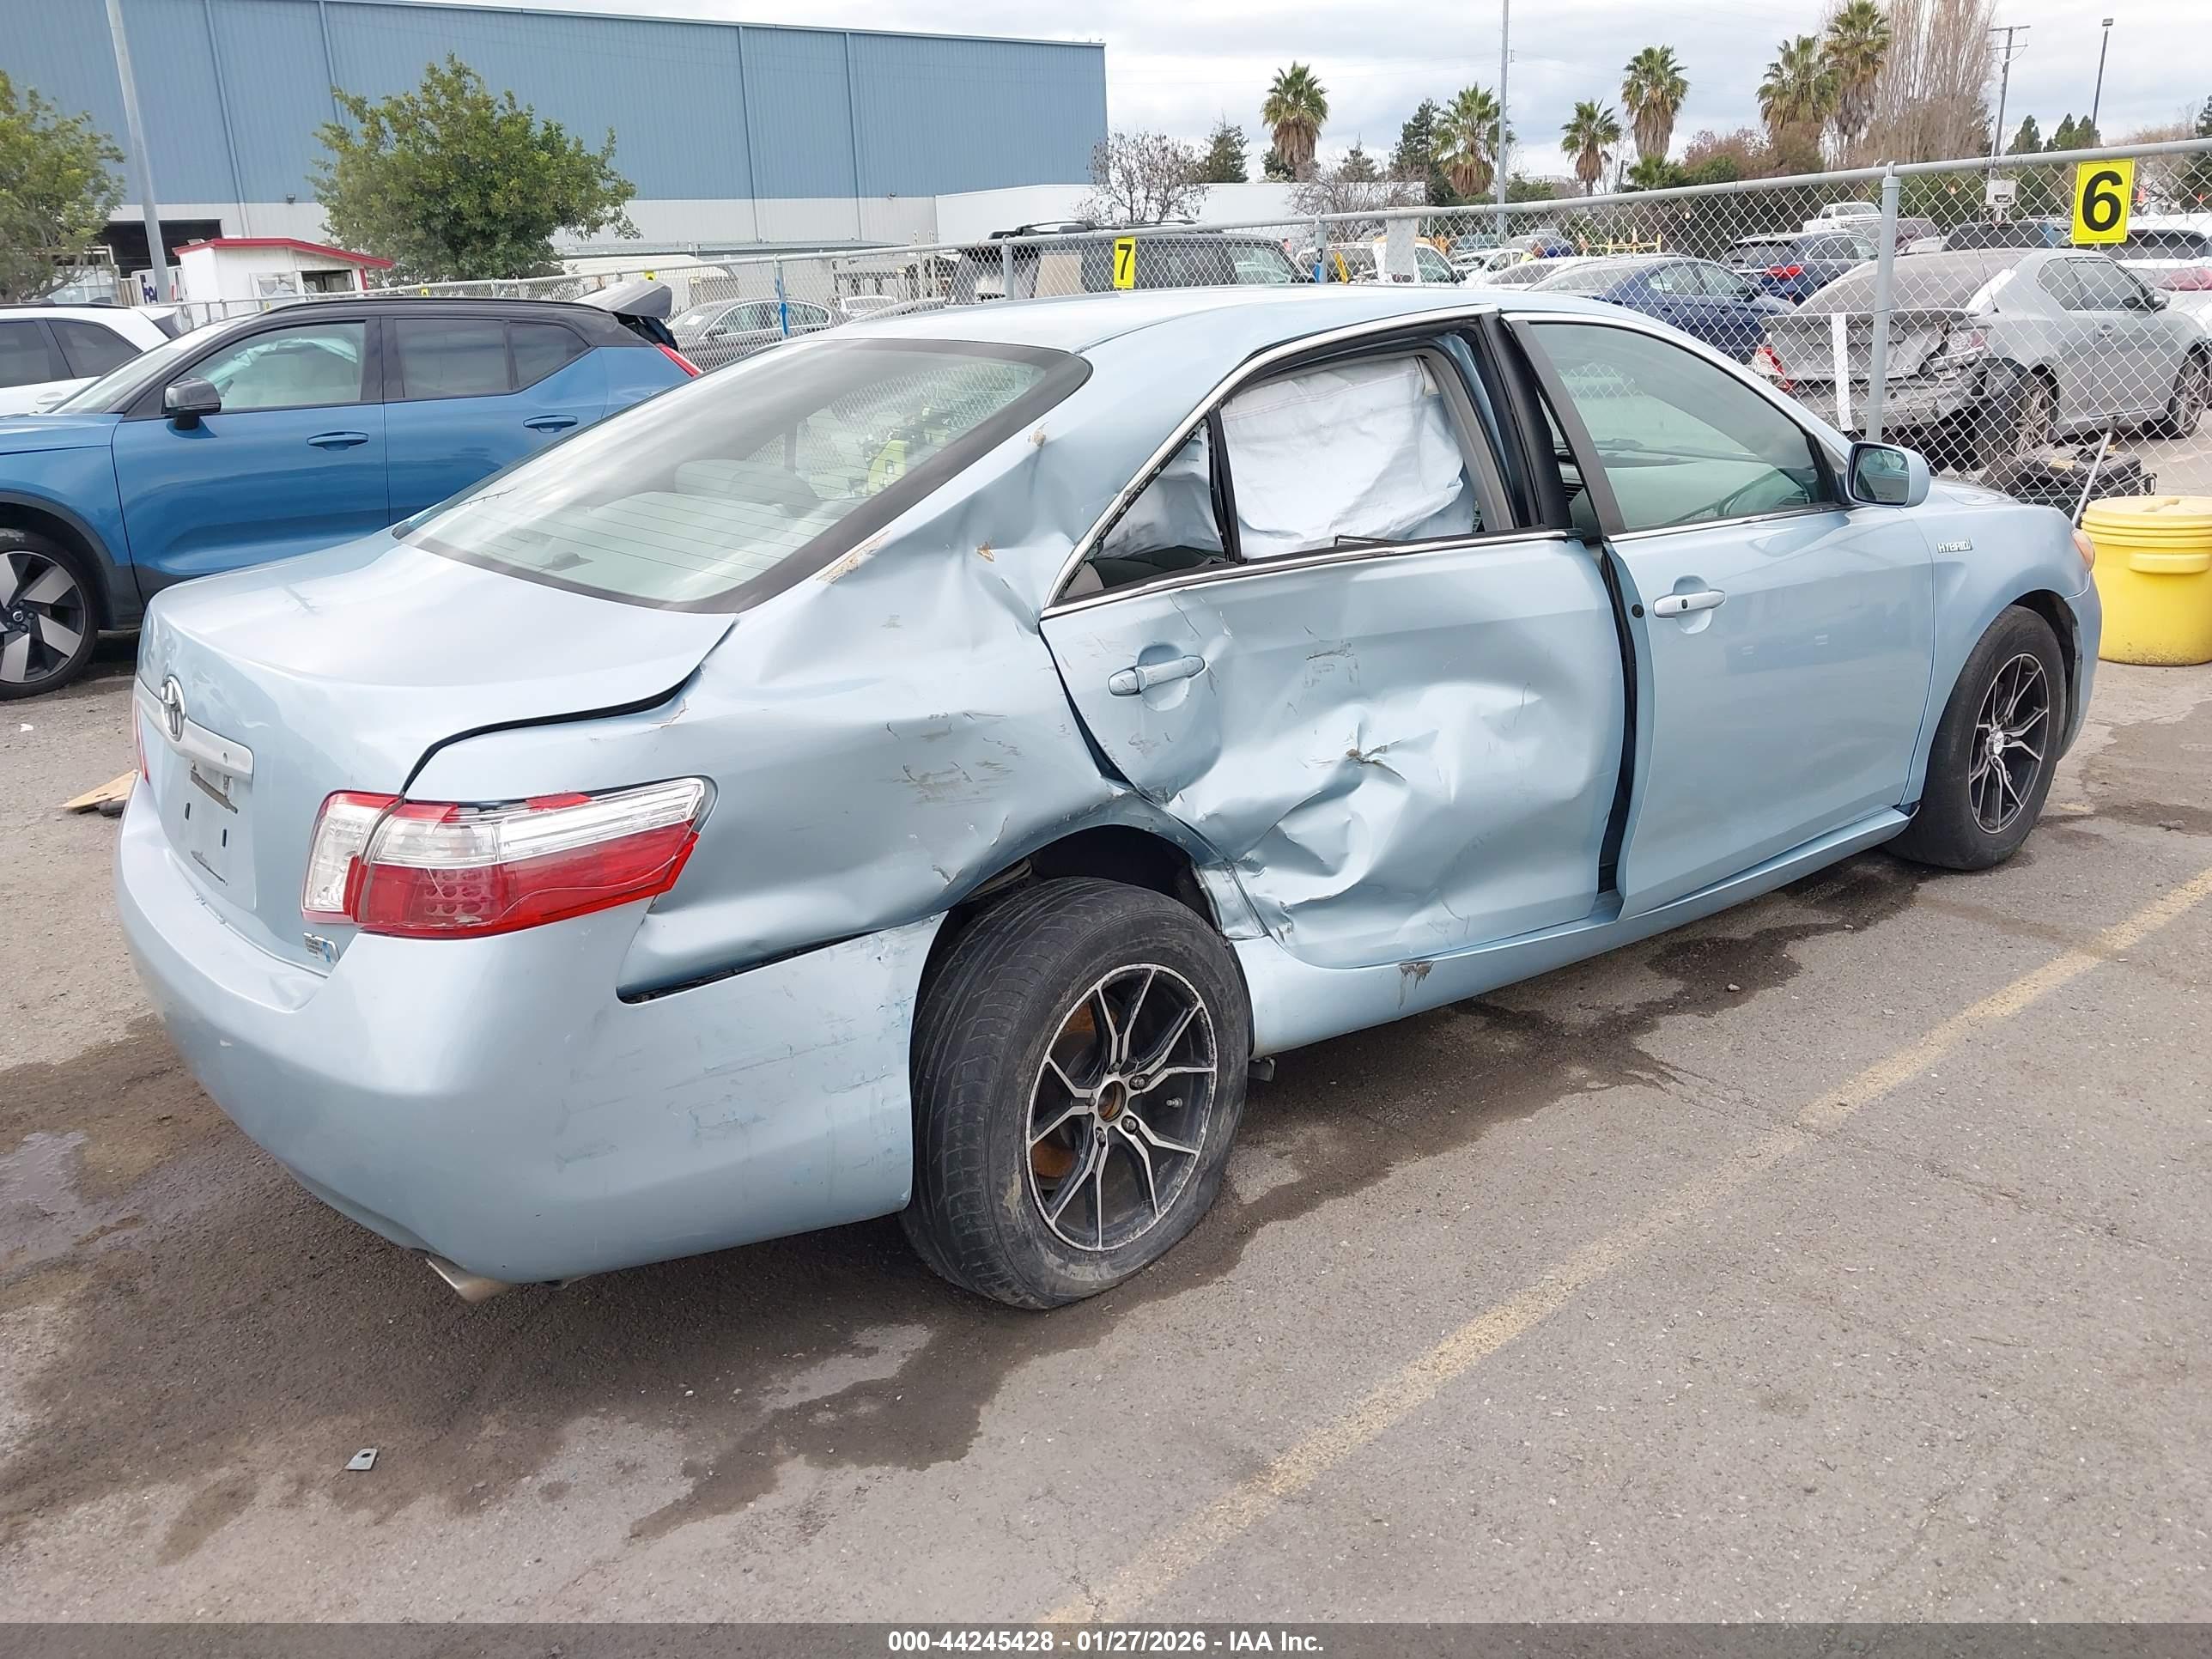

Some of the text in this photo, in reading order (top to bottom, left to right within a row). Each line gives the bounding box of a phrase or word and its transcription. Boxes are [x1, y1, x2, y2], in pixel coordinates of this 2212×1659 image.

[2082, 170, 2124, 232] 6
[1118, 244, 1132, 280] 7
[1316, 247, 1323, 264] 3
[1936, 541, 1972, 554] HYBRID
